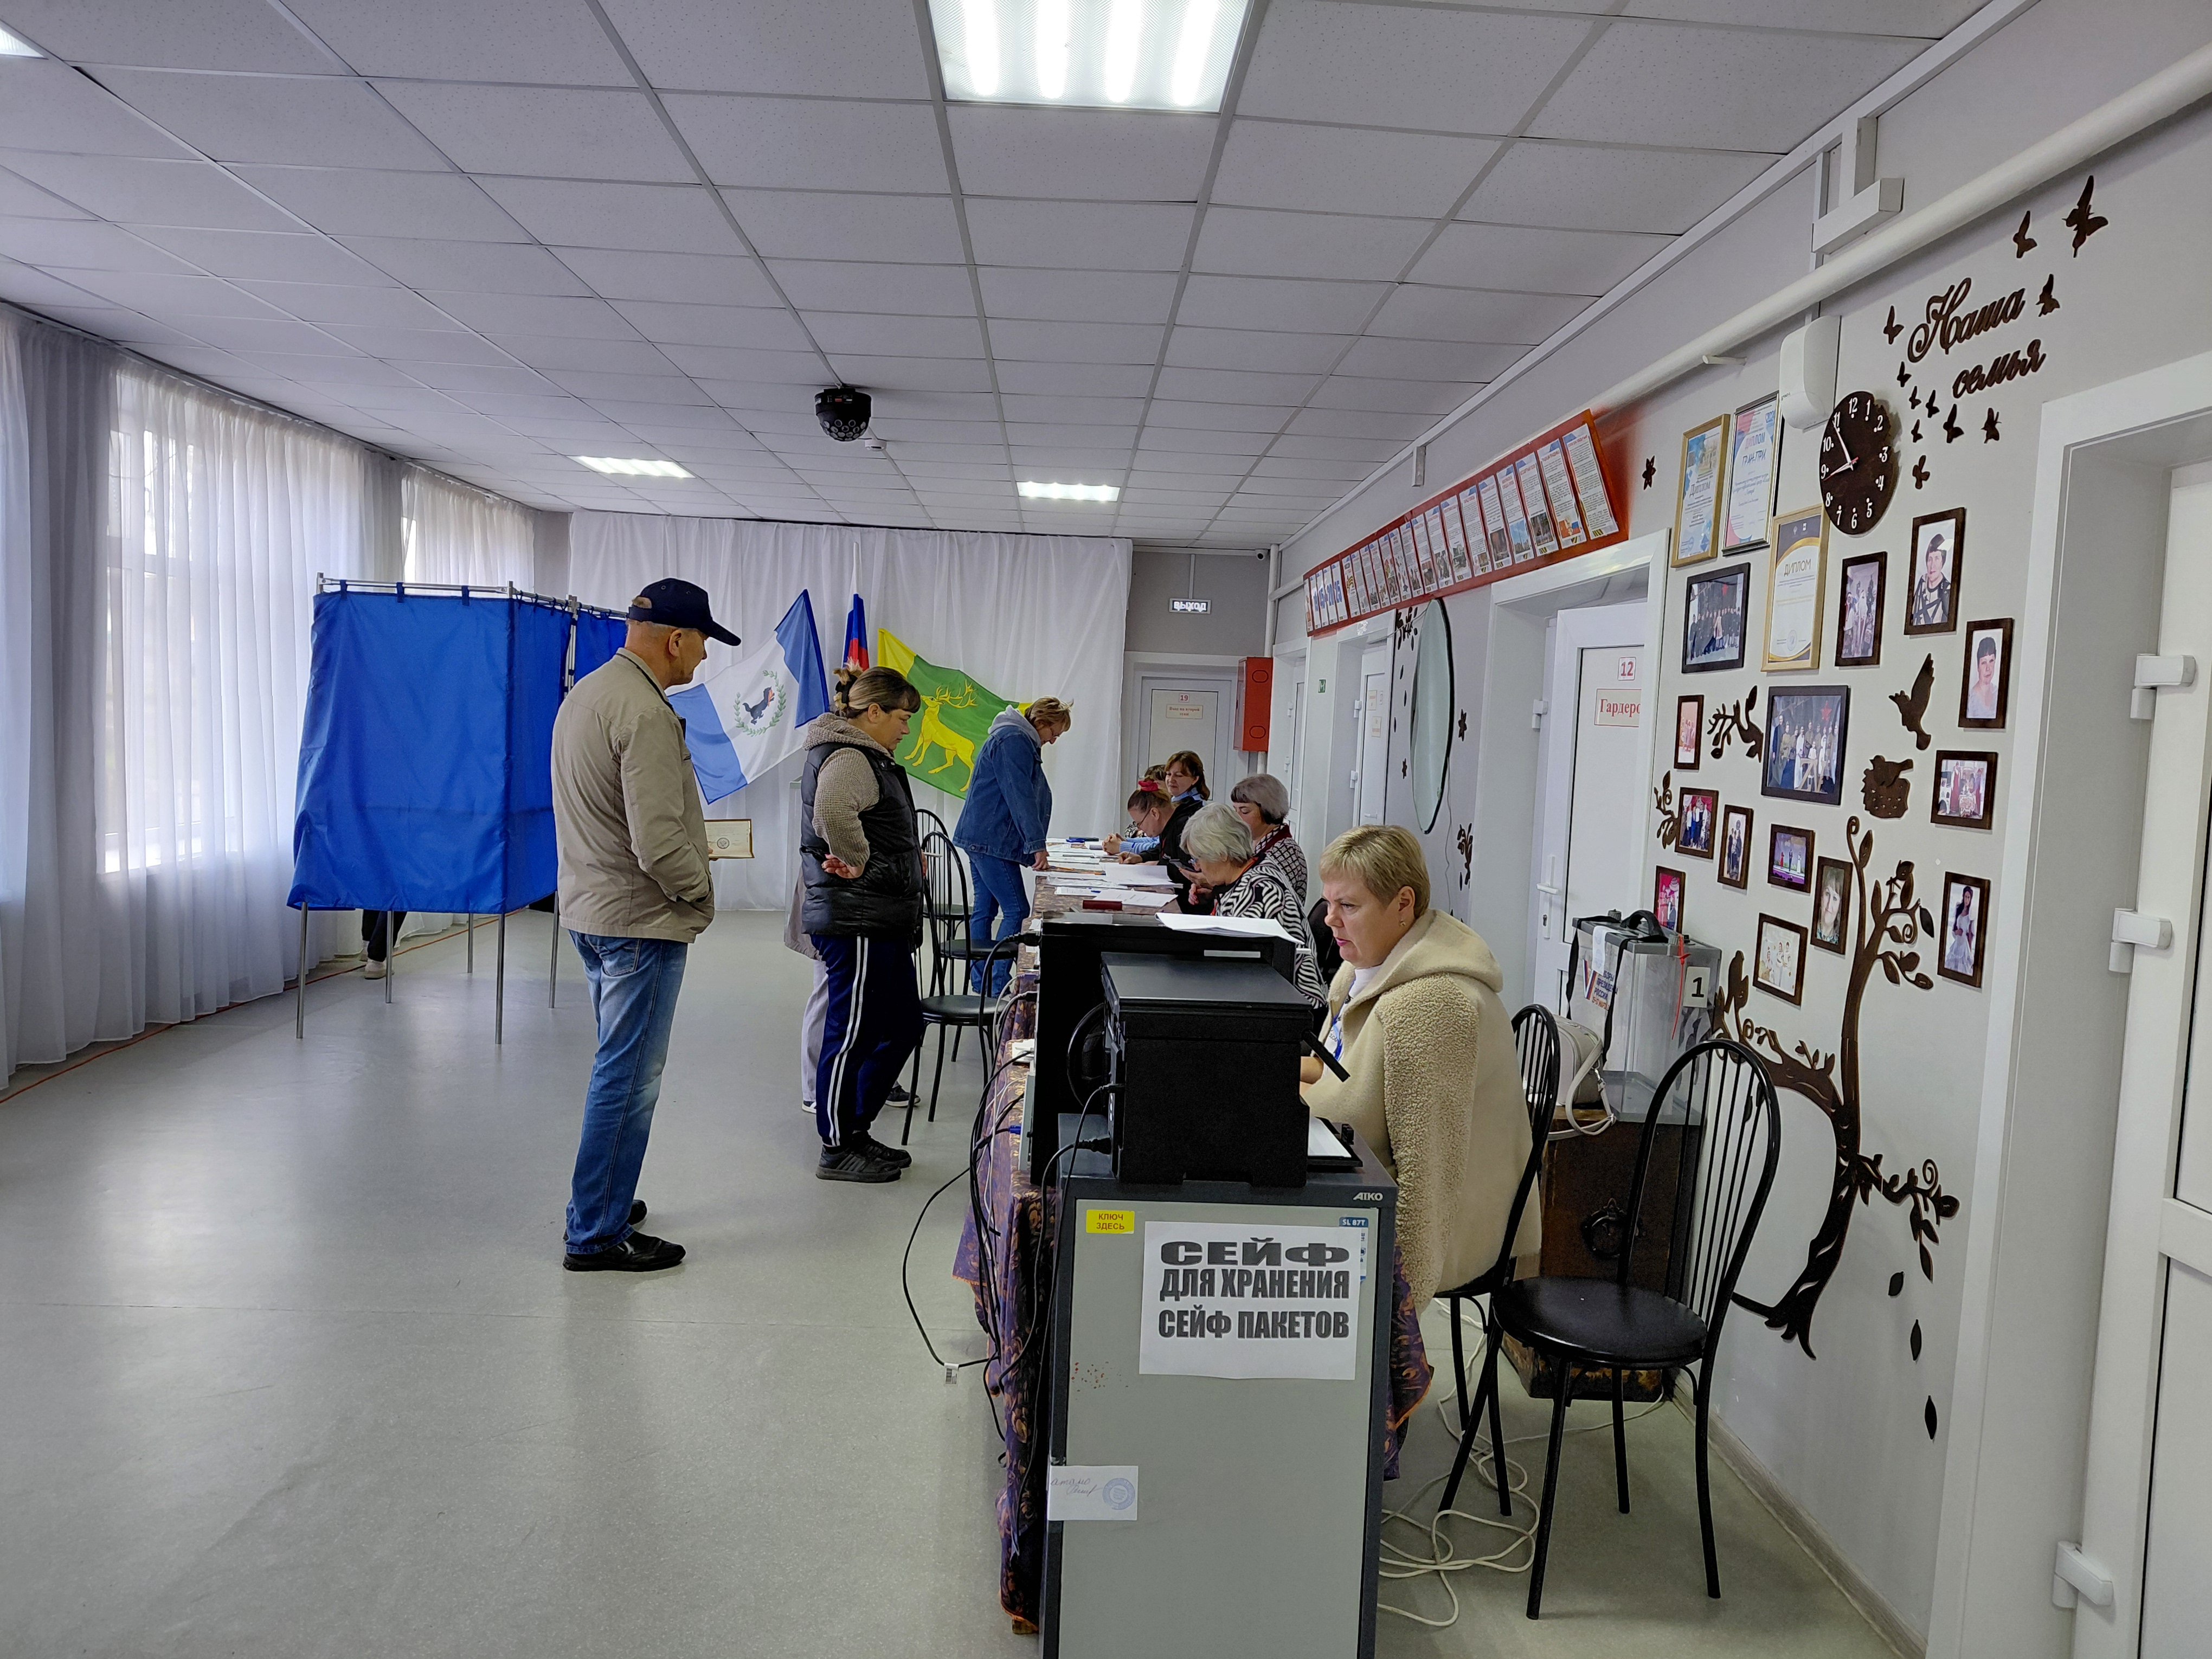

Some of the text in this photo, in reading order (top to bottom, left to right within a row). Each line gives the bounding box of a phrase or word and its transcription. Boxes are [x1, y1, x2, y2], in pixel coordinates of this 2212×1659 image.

[1907, 277, 2025, 363] Наша
[1952, 339, 2047, 399] семья
[1849, 397, 1858, 414] 12
[1866, 400, 1870, 416] 1
[1877, 415, 1883, 431] 2
[1745, 432, 1766, 449] ДИПЛОМ
[1823, 436, 1831, 453] 10
[1881, 446, 1888, 462] 3
[1821, 464, 1826, 479] 9
[1877, 475, 1885, 491] 4
[1825, 492, 1831, 507] 8
[1836, 510, 1842, 526] 7
[1867, 502, 1873, 518] 5
[1851, 513, 1857, 529] 6
[1784, 558, 1812, 577] ДИПЛОМ
[1173, 601, 1207, 611] ВЫХОД
[1621, 661, 1634, 677] 12
[1600, 698, 1641, 718] Гардеро
[1692, 977, 1705, 998] 1
[1353, 1192, 1383, 1201] AIKO
[1096, 1223, 1124, 1231] ЗДЕСЬ
[1161, 1237, 1349, 1266] СЕЙФ
[1160, 1269, 1350, 1302] ДЛЯ ХРАНЕНИЯ
[1159, 1304, 1349, 1339] СЕЙФ ПАКЕТОВ
